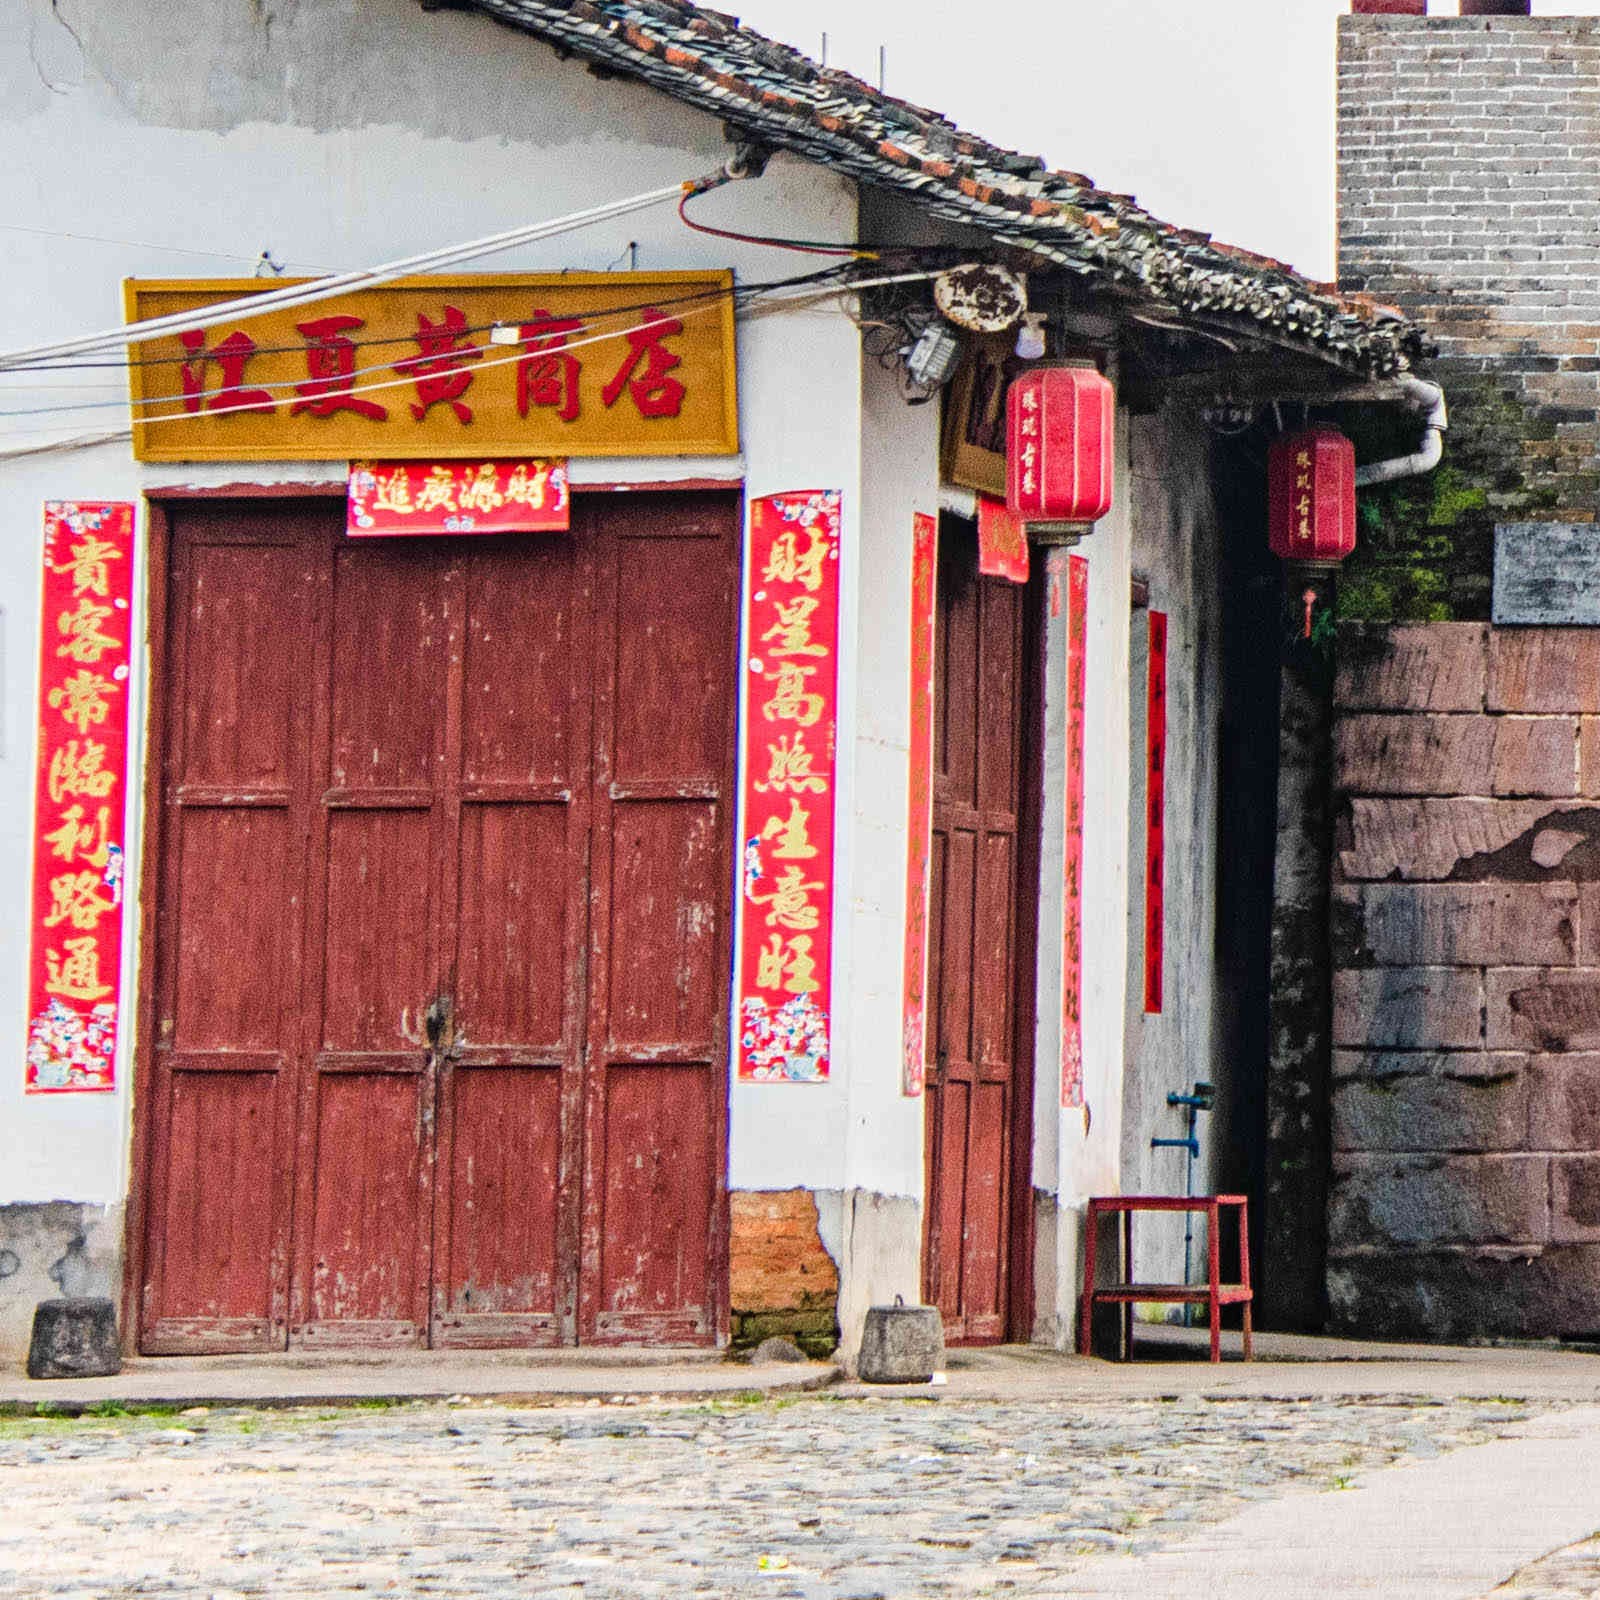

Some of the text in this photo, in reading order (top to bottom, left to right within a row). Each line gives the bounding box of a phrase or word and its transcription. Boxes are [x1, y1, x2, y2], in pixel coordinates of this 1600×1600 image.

[178, 305, 689, 424] 江夏黄商店
[43, 535, 123, 1001] 貴客常臨利路通
[752, 526, 829, 994] 財星高照生意旺
